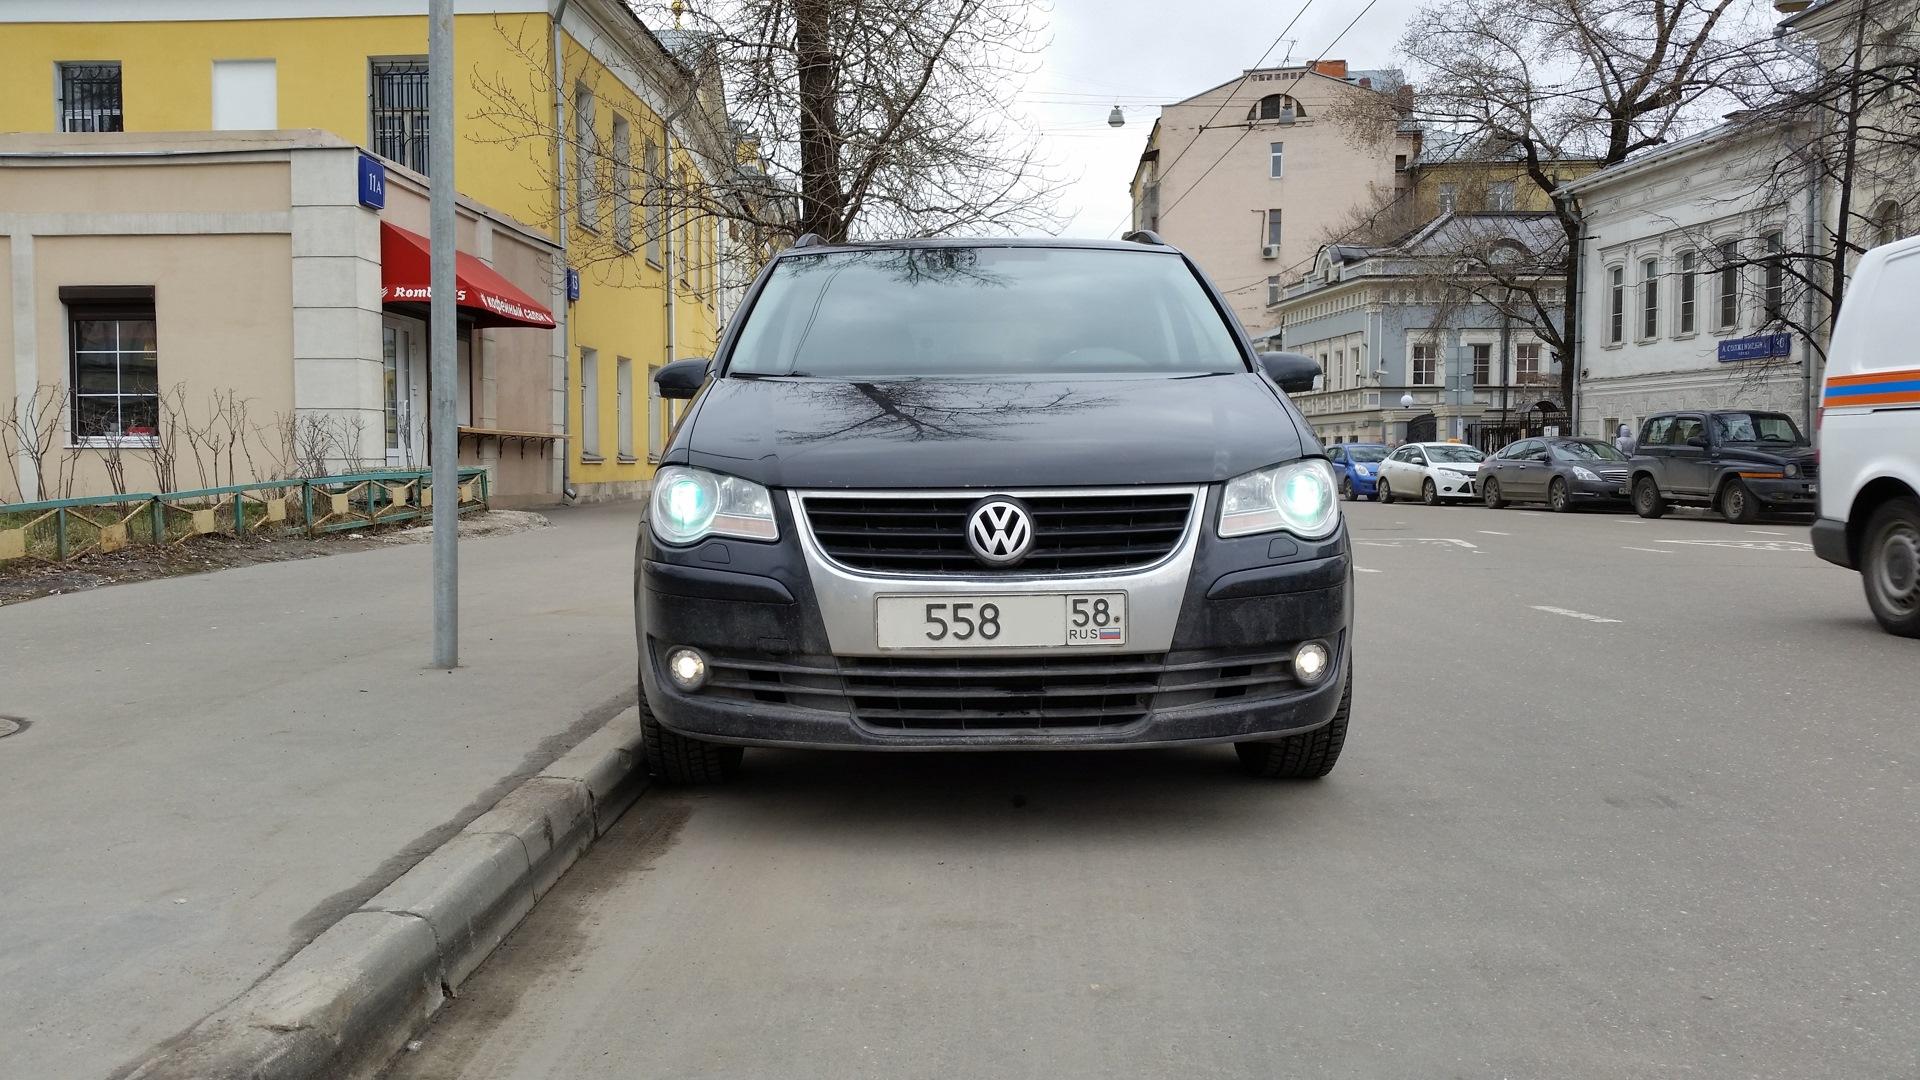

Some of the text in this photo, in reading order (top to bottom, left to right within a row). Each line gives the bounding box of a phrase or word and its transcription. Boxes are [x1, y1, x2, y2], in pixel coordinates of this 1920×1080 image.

[487, 296, 547, 322] кофейный салон
[925, 598, 1112, 641] 558 58
[1069, 629, 1099, 640] RUS
